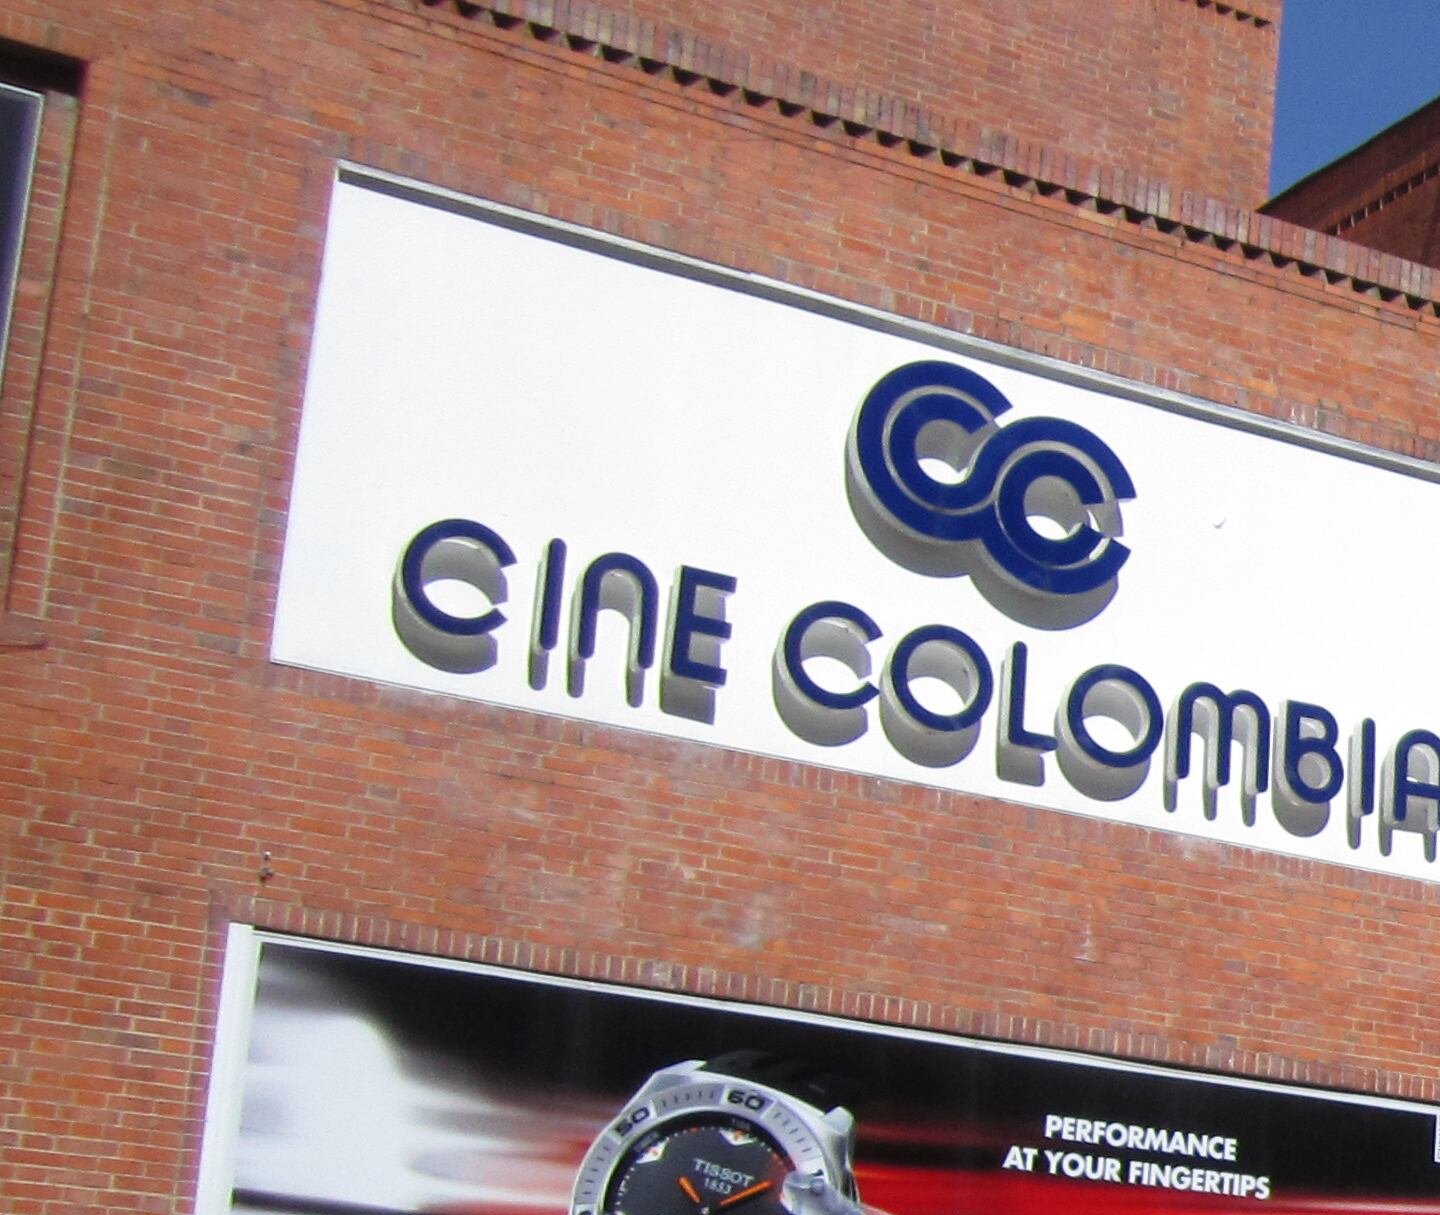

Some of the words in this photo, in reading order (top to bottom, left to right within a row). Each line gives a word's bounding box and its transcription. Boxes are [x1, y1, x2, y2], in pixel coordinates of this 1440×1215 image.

[398, 516, 740, 688] CINE
[726, 1089, 765, 1110] 60
[1044, 1113, 1239, 1163] PERFORMANCE
[692, 1157, 755, 1186] TISSOT
[1001, 1145, 1041, 1171] AT
[1044, 1148, 1122, 1183] YOUR
[1127, 1160, 1272, 1201] FINGERTIPS
